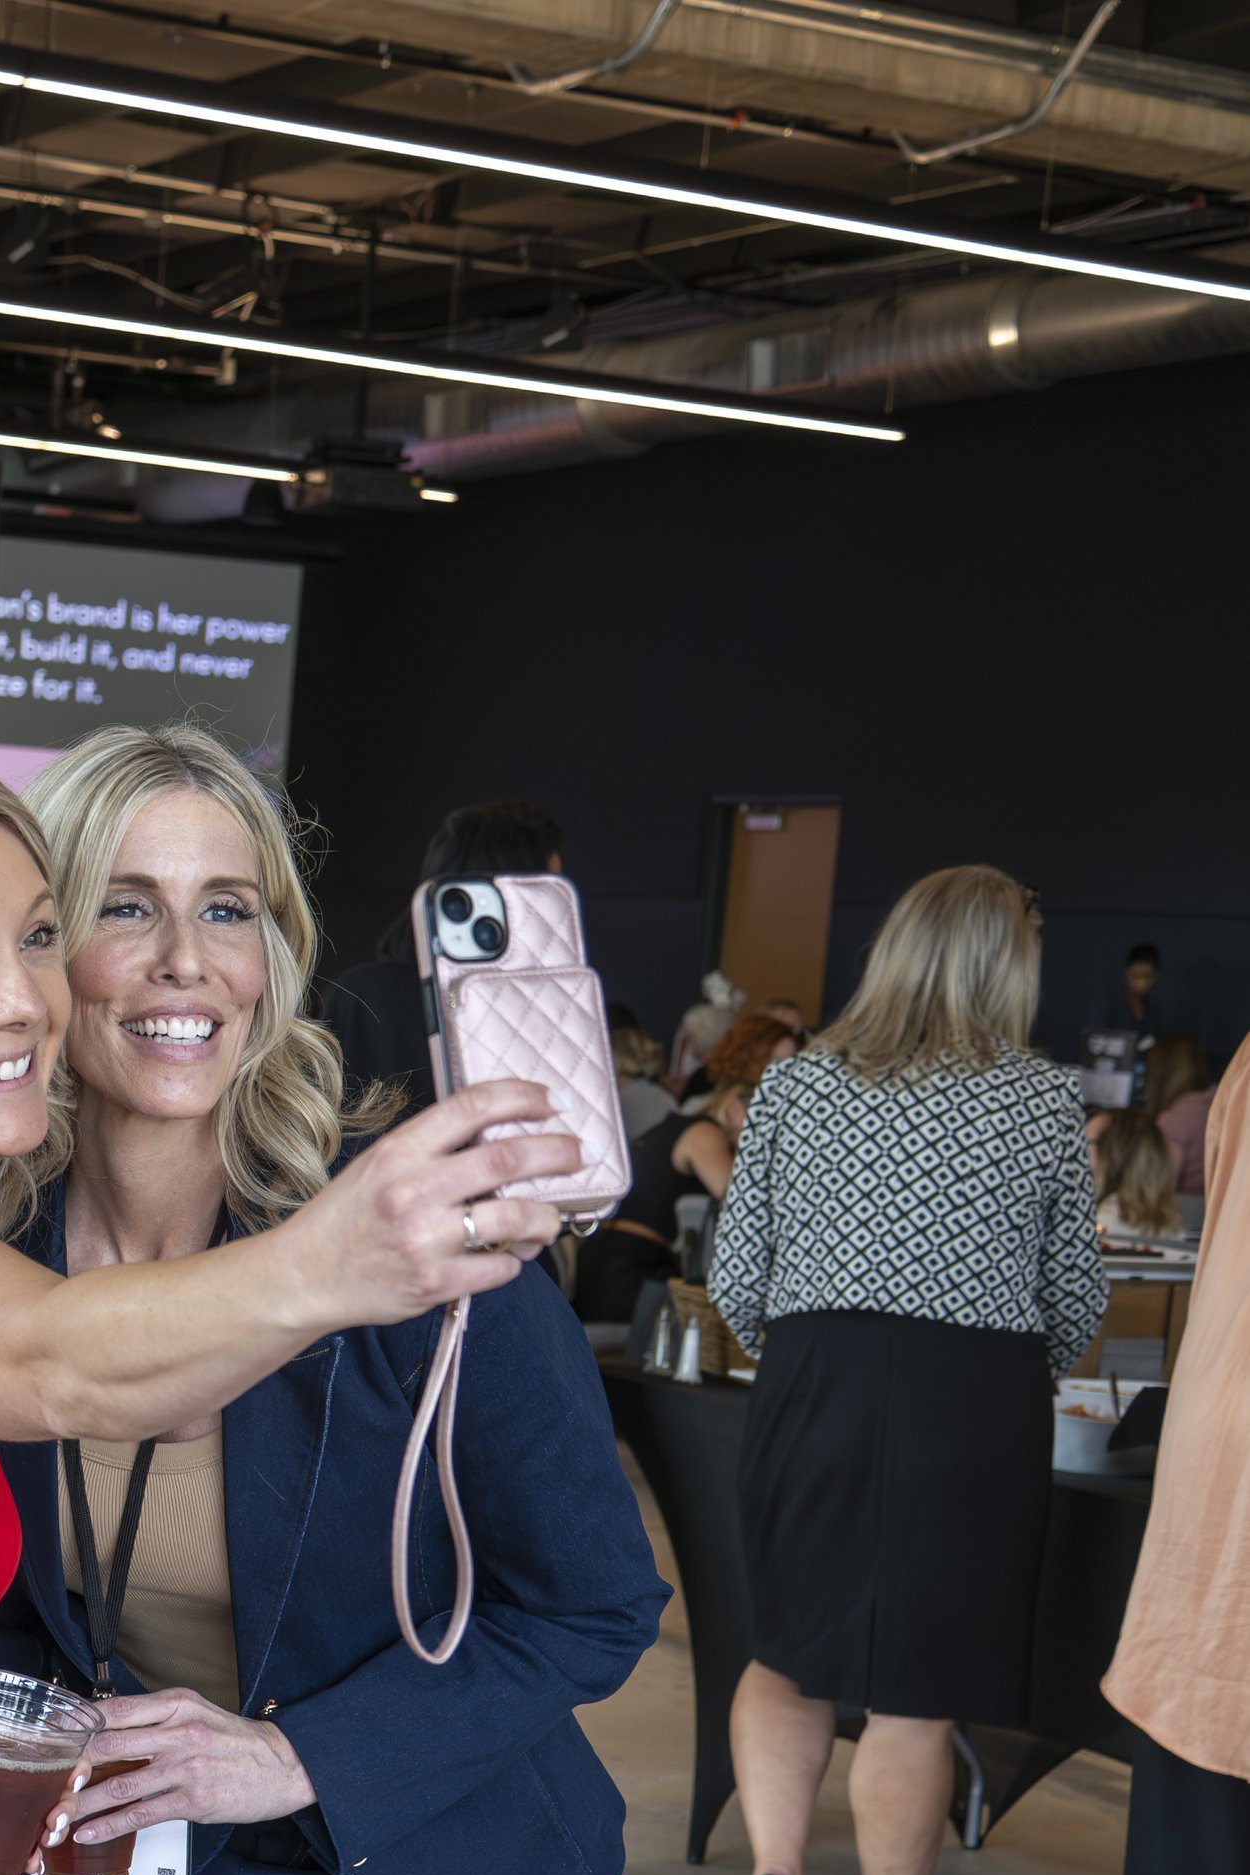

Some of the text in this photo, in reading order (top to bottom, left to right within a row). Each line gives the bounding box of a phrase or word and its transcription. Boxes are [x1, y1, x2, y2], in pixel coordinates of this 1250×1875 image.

[48, 592, 127, 629] brand
[131, 604, 153, 632] is
[157, 602, 202, 635] her
[205, 617, 291, 646] power
[20, 628, 87, 664] build
[91, 640, 118, 671] it,
[122, 641, 176, 672] and
[179, 653, 253, 679] never
[31, 668, 72, 701] for
[75, 677, 102, 704] it.
